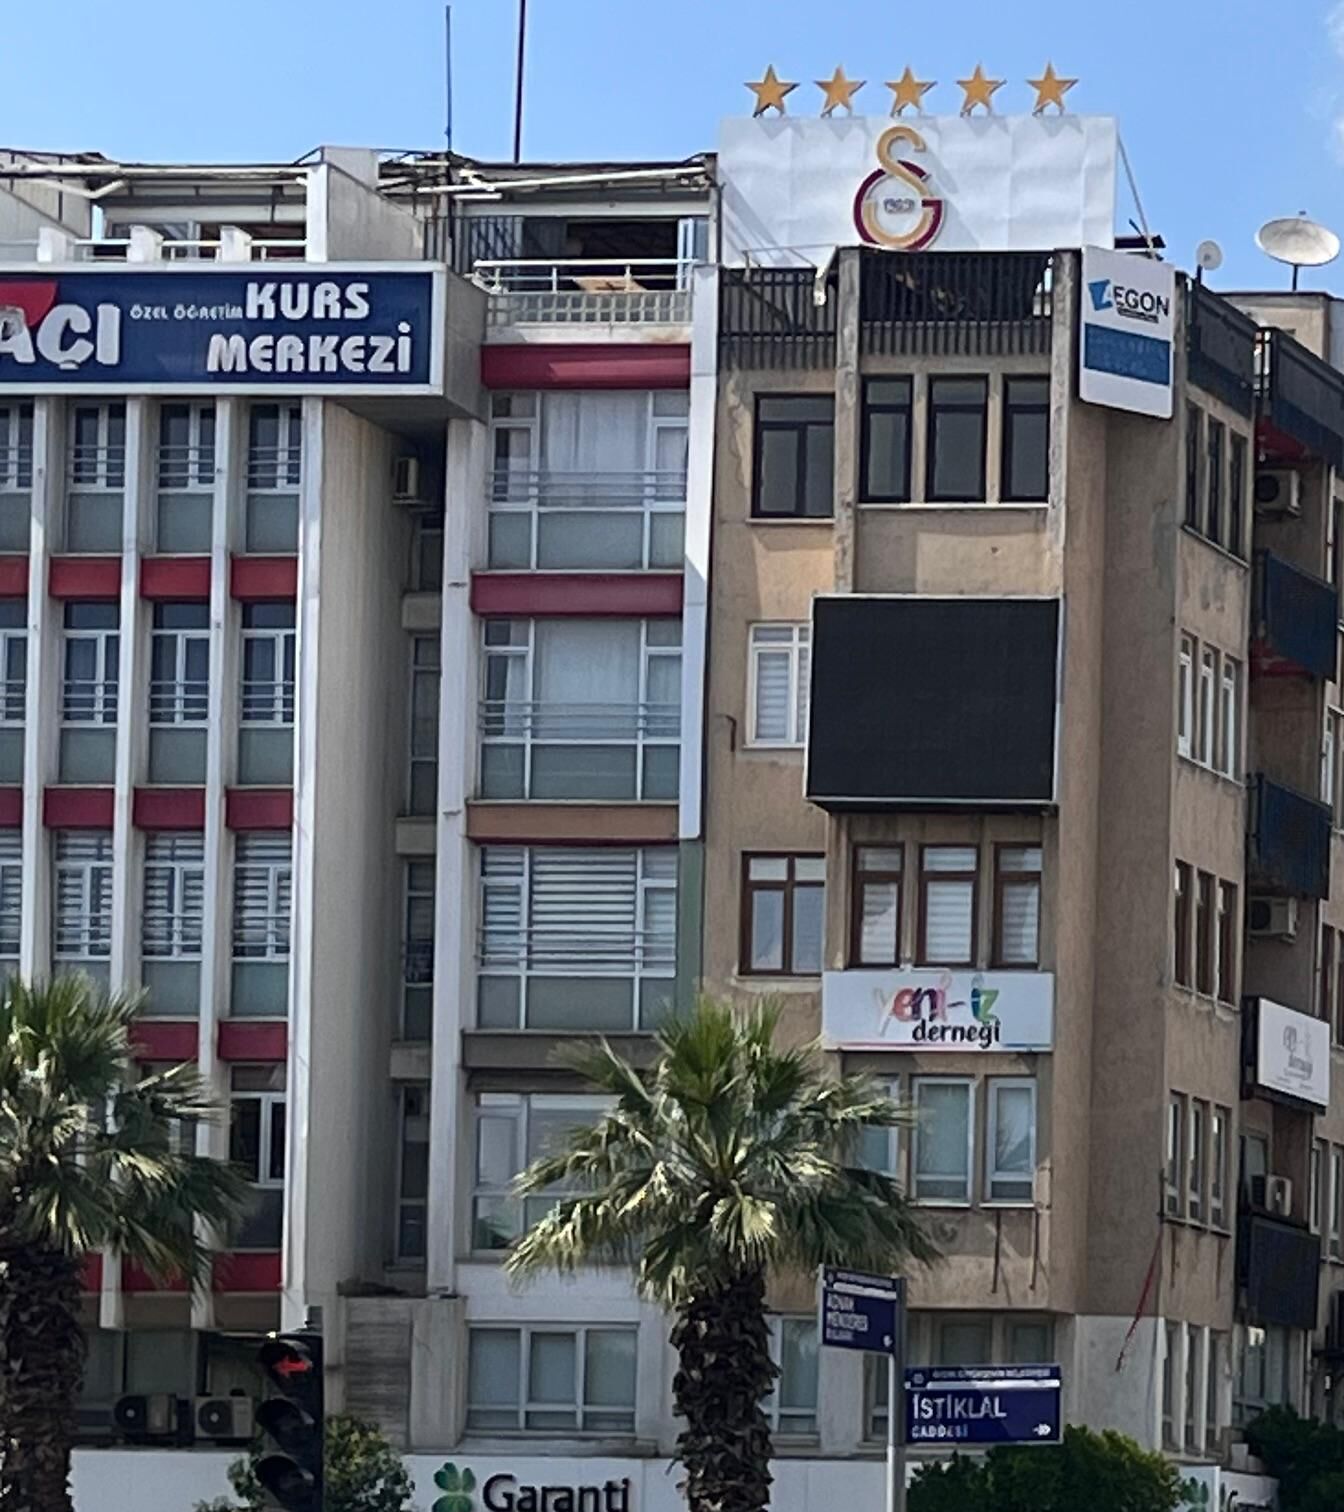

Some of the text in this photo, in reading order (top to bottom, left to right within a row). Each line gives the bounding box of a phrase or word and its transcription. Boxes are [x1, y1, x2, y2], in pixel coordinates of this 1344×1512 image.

[129, 303, 168, 321] ÖZEL
[246, 282, 370, 320] KURS
[207, 321, 411, 373] MERKEZİ
[912, 1393, 1008, 1419] İSTİKLAL
